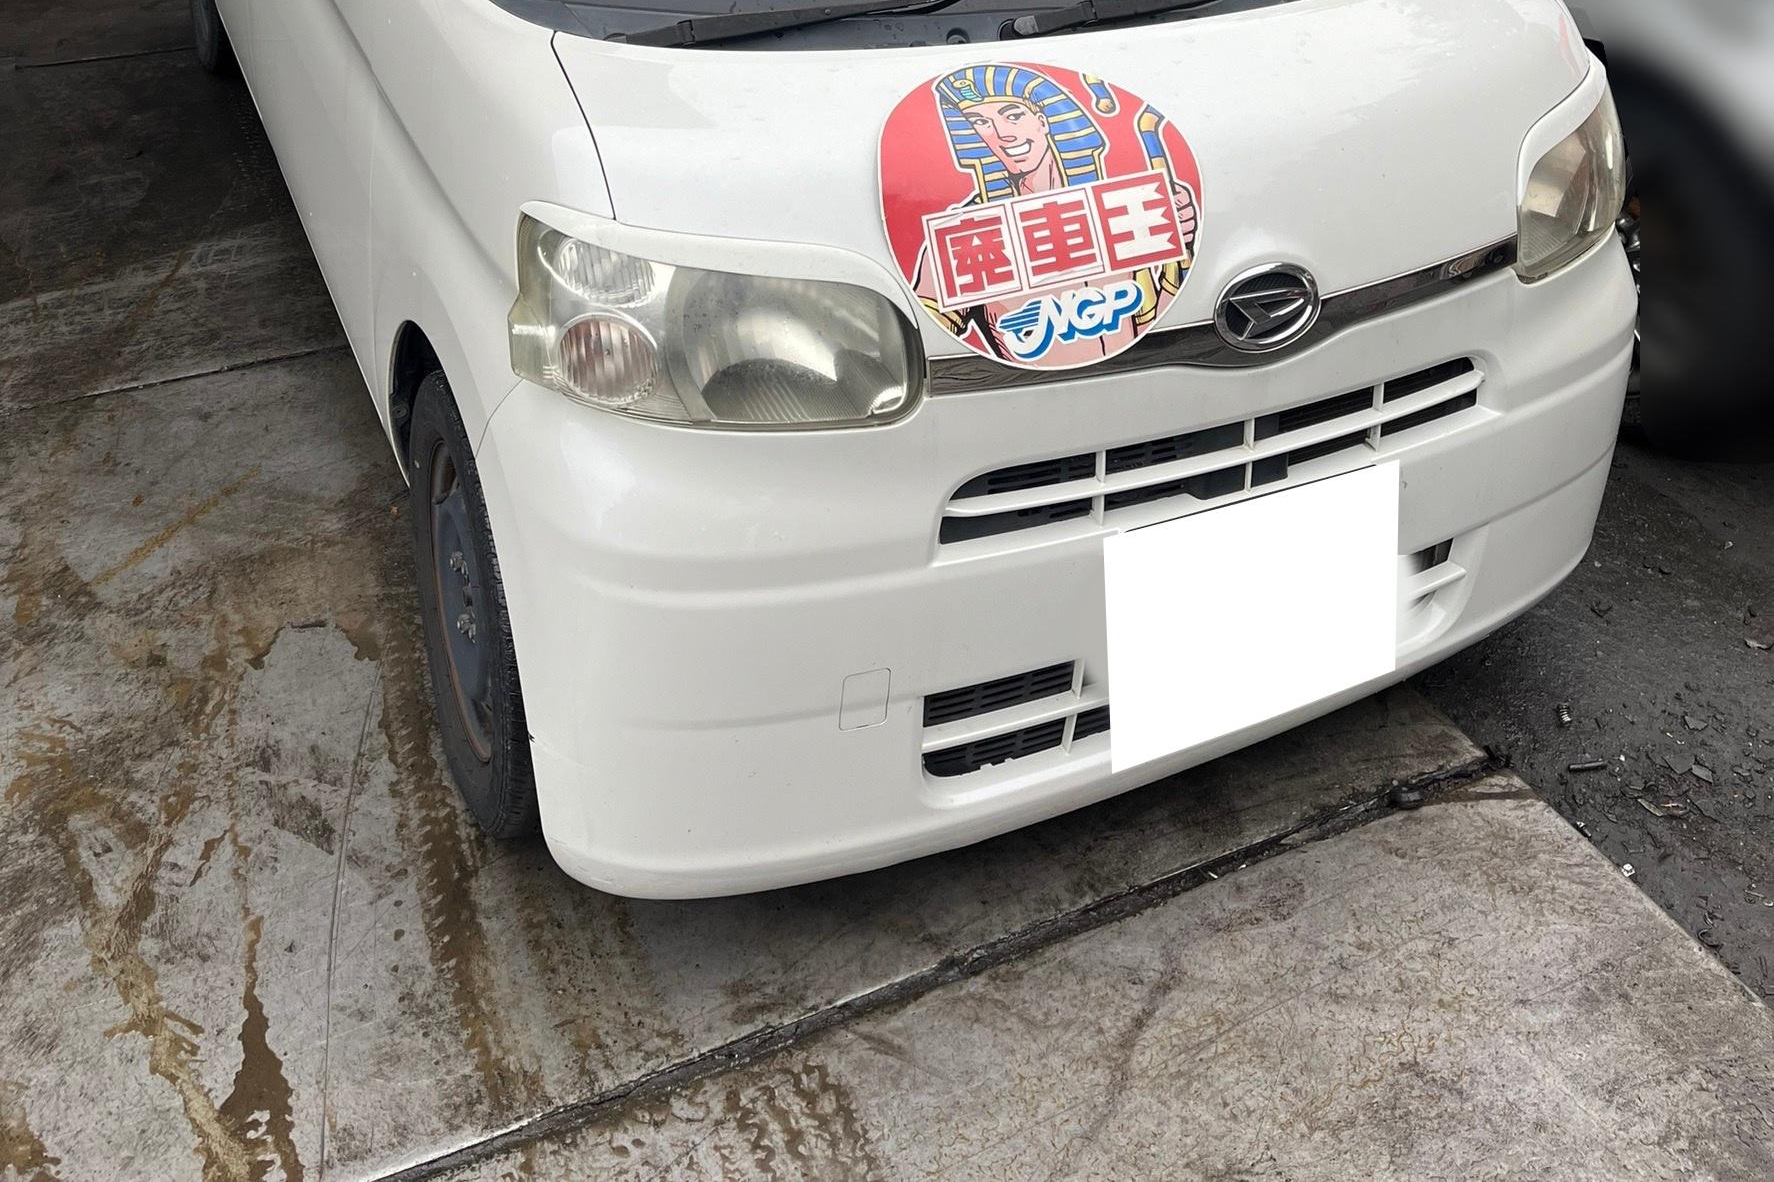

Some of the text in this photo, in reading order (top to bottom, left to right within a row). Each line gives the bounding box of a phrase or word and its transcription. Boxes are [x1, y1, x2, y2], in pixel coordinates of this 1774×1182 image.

[933, 180, 1177, 299] 廃車王
[999, 281, 1143, 359] NGP
